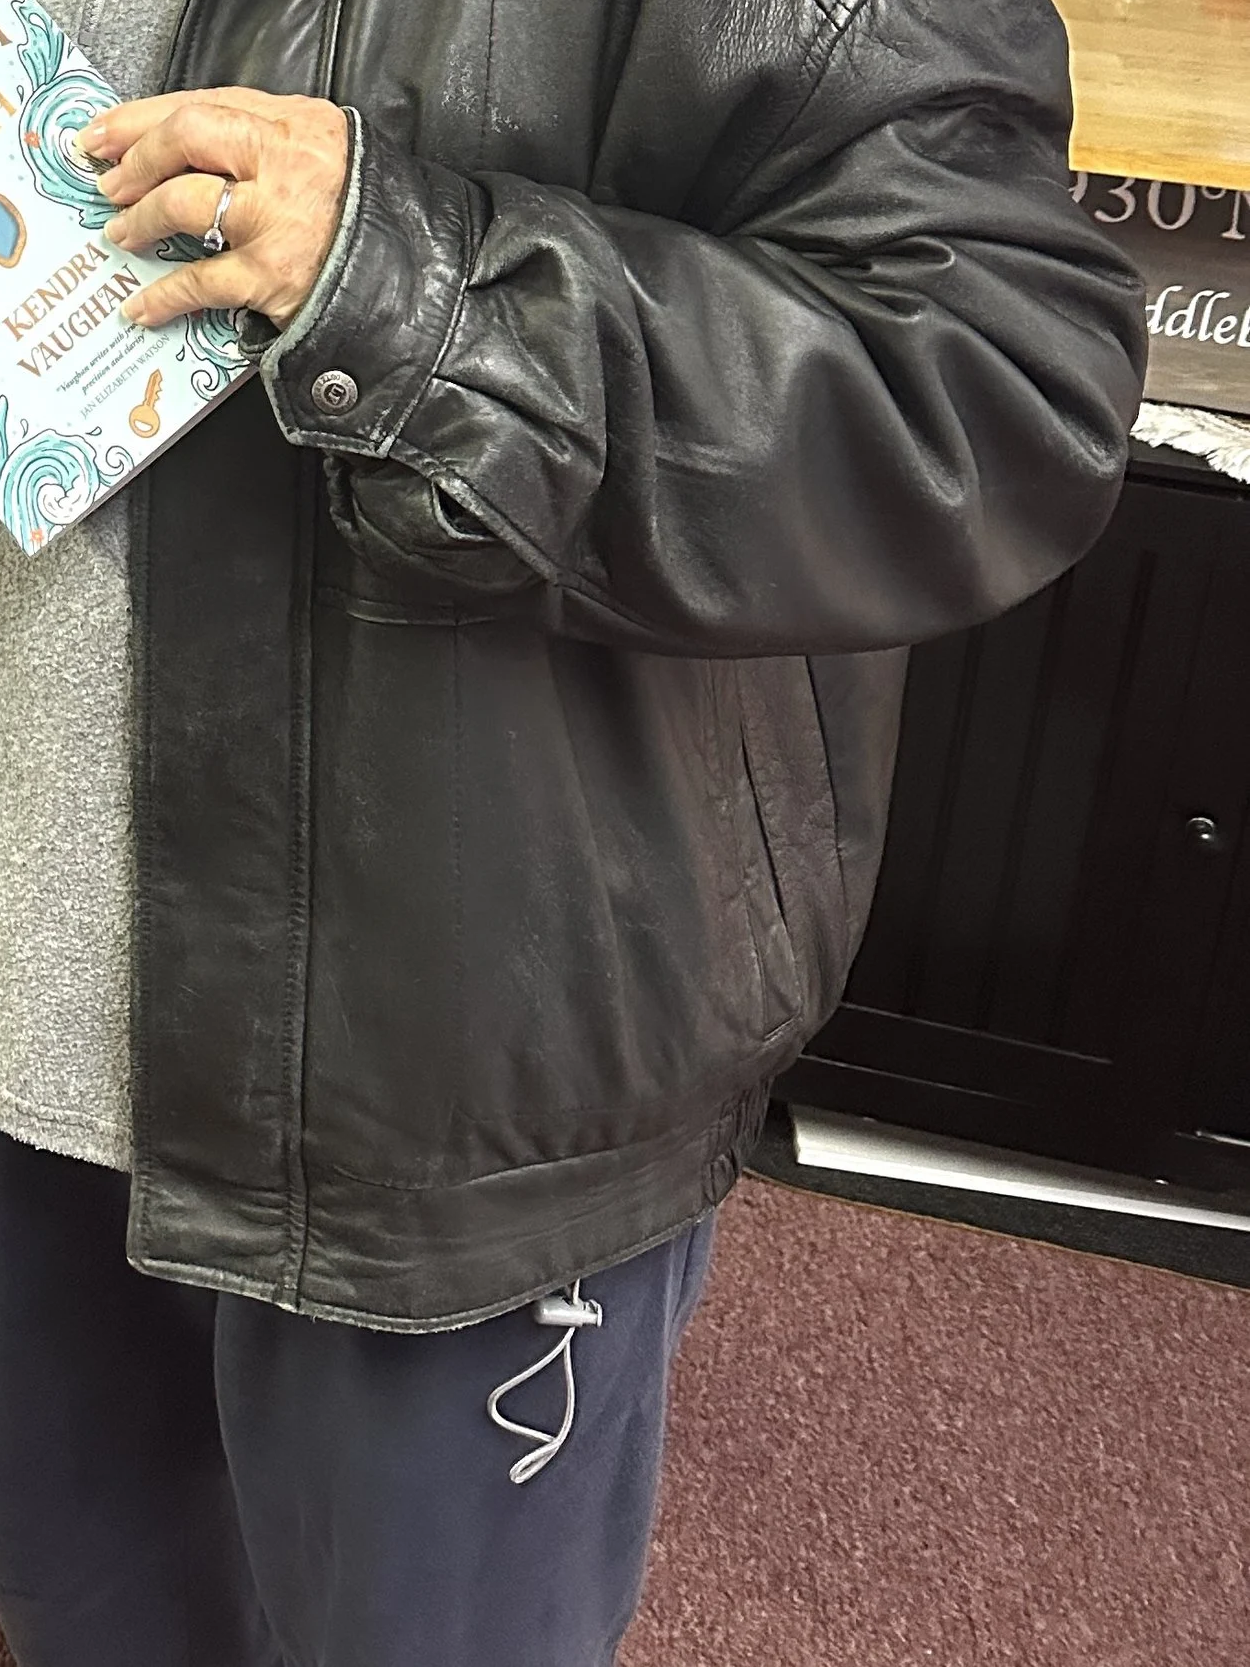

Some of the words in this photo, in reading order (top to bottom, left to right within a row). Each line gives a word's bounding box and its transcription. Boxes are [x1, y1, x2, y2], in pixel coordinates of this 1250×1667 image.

[1, 241, 110, 342] KENDRA
[16, 264, 142, 378] VAUGHAN
[80, 401, 97, 420] JAN
[95, 364, 140, 404] ELIZABETH
[136, 333, 171, 365] WATSON
[81, 365, 111, 396] precision
[111, 350, 124, 368] and
[90, 347, 109, 368] writes
[109, 331, 125, 350] with
